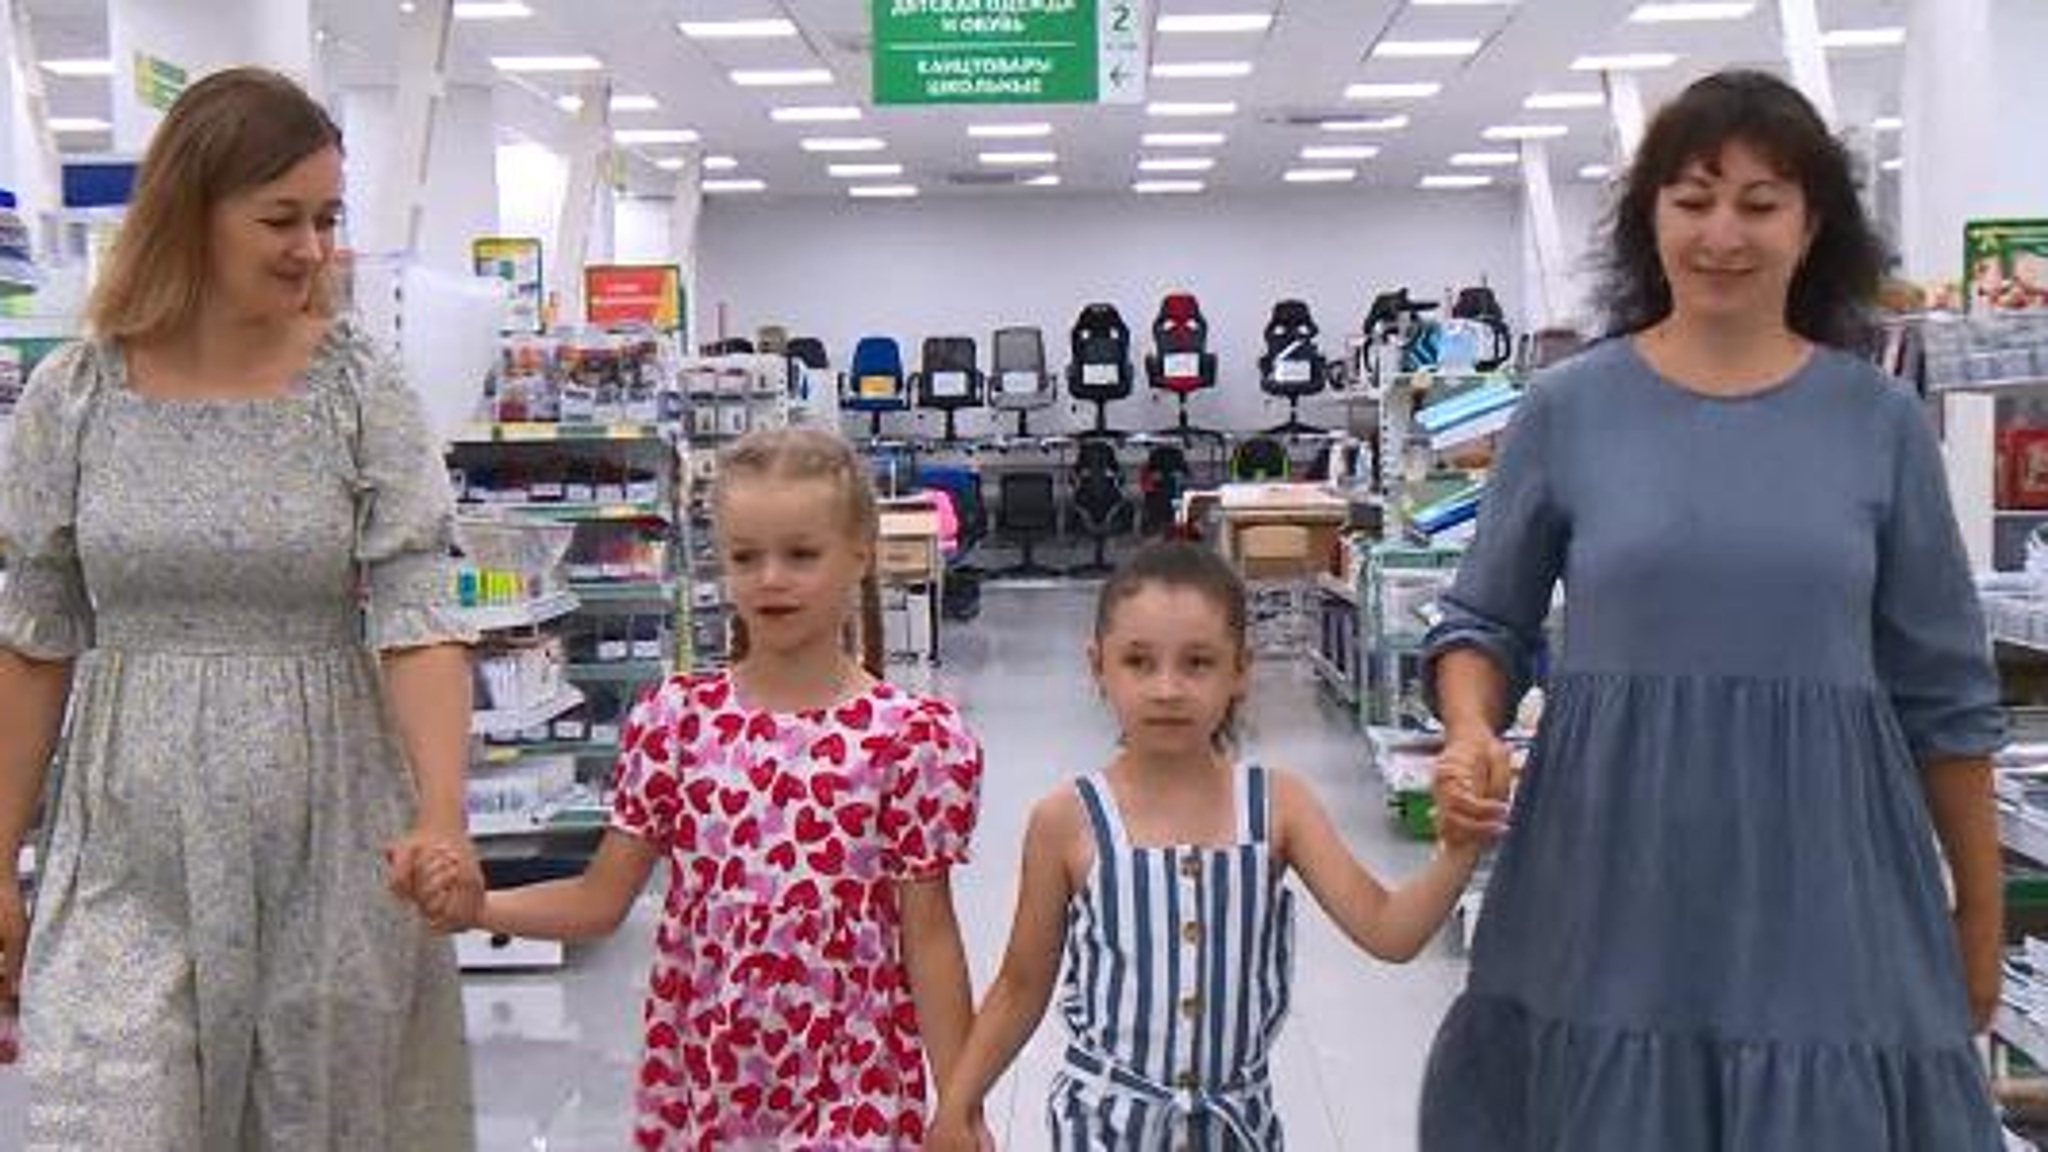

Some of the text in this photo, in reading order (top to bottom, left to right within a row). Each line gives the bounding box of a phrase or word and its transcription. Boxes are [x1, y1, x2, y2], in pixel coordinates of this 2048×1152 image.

[960, 18, 1026, 33] ОБУВЬ
[1111, 4, 1130, 31] 2
[918, 57, 1053, 75] КАНЦТОВАРЫ
[925, 78, 1043, 95] ШКОЛЬНЫЕ
